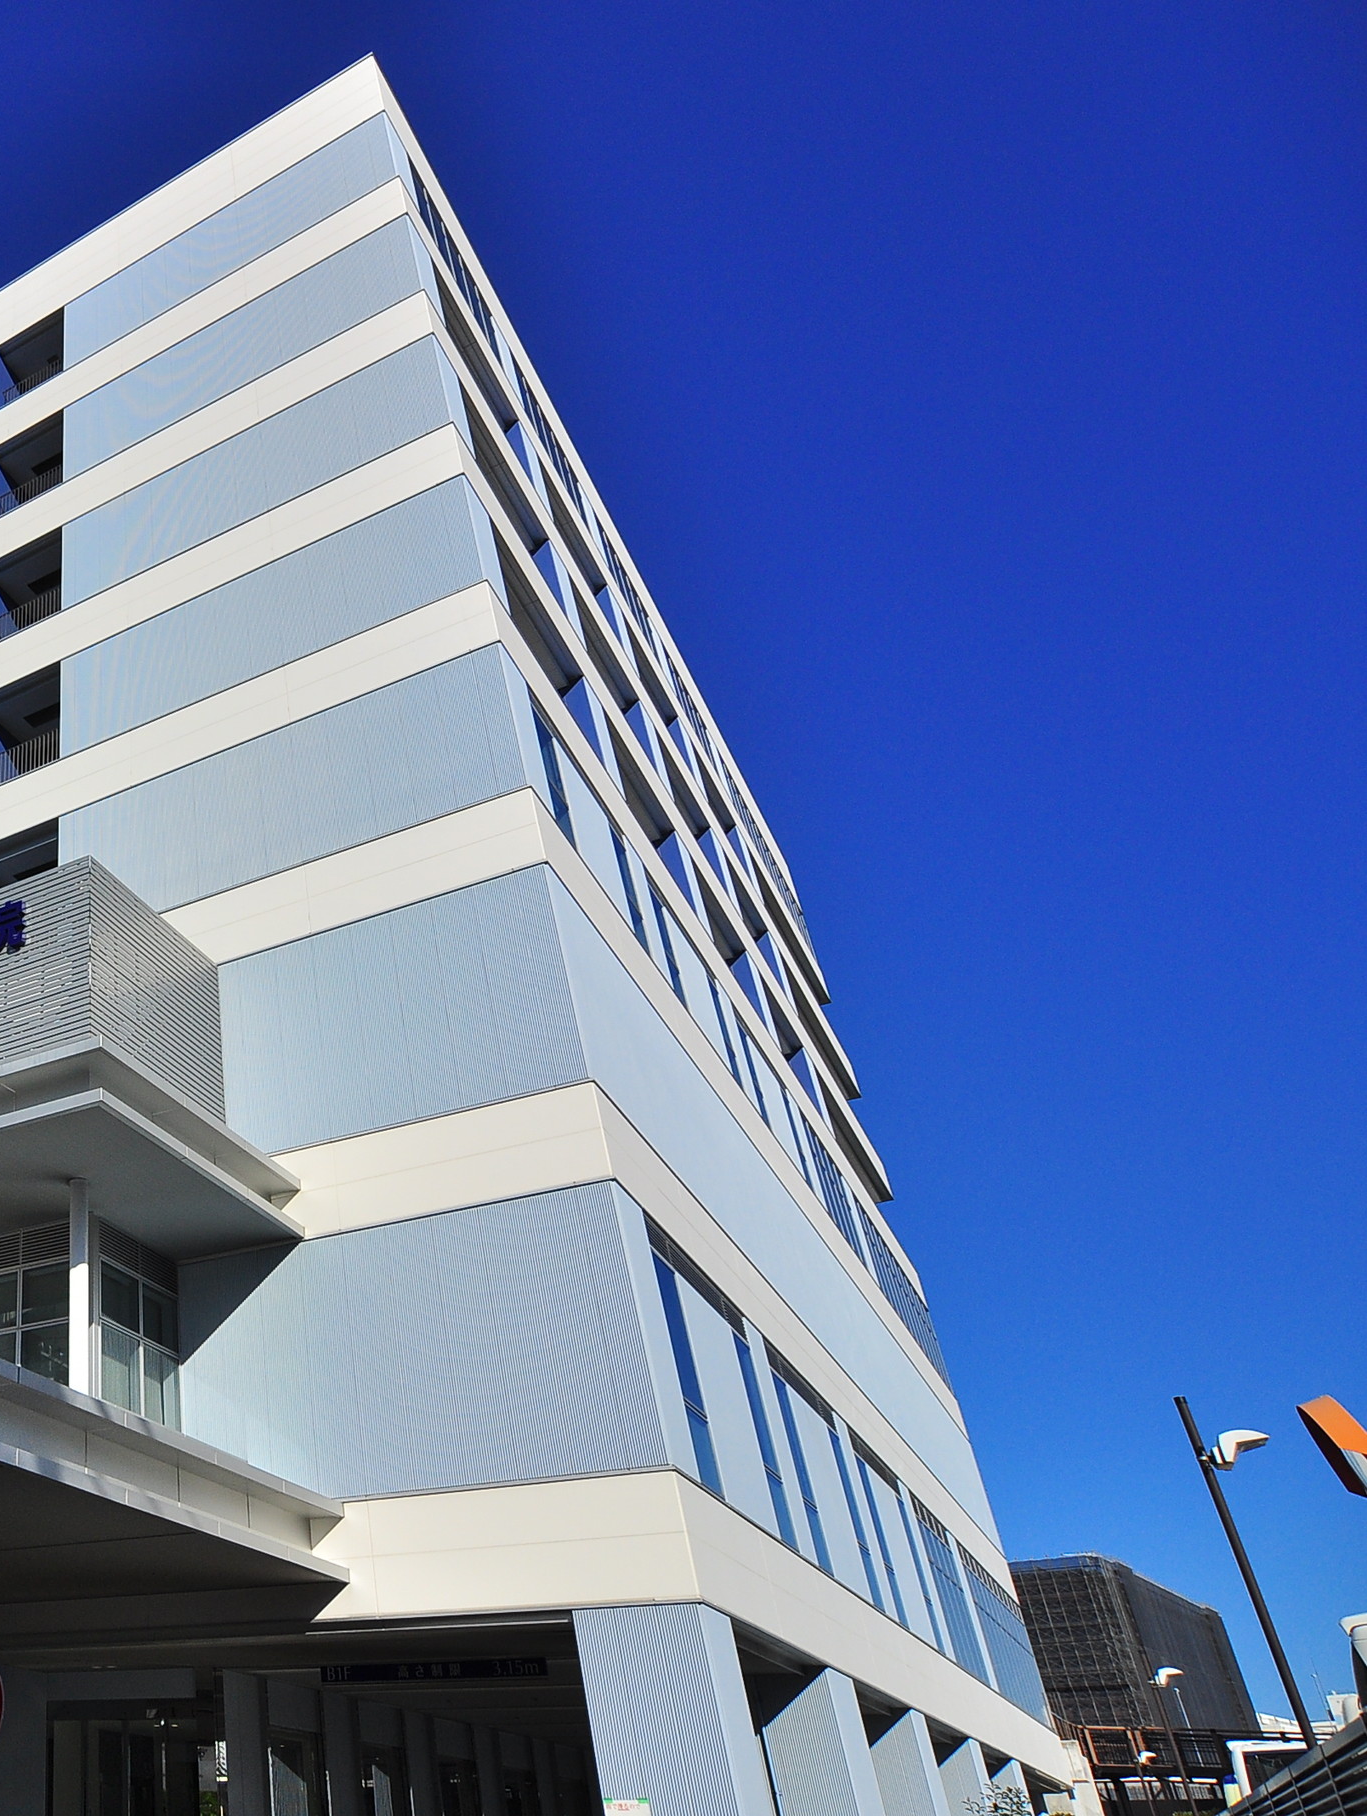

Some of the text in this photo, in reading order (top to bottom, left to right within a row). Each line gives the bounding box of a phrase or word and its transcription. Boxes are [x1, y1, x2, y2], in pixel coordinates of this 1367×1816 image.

[326, 1660, 540, 1681] B1F 高さ制限 3.15m
